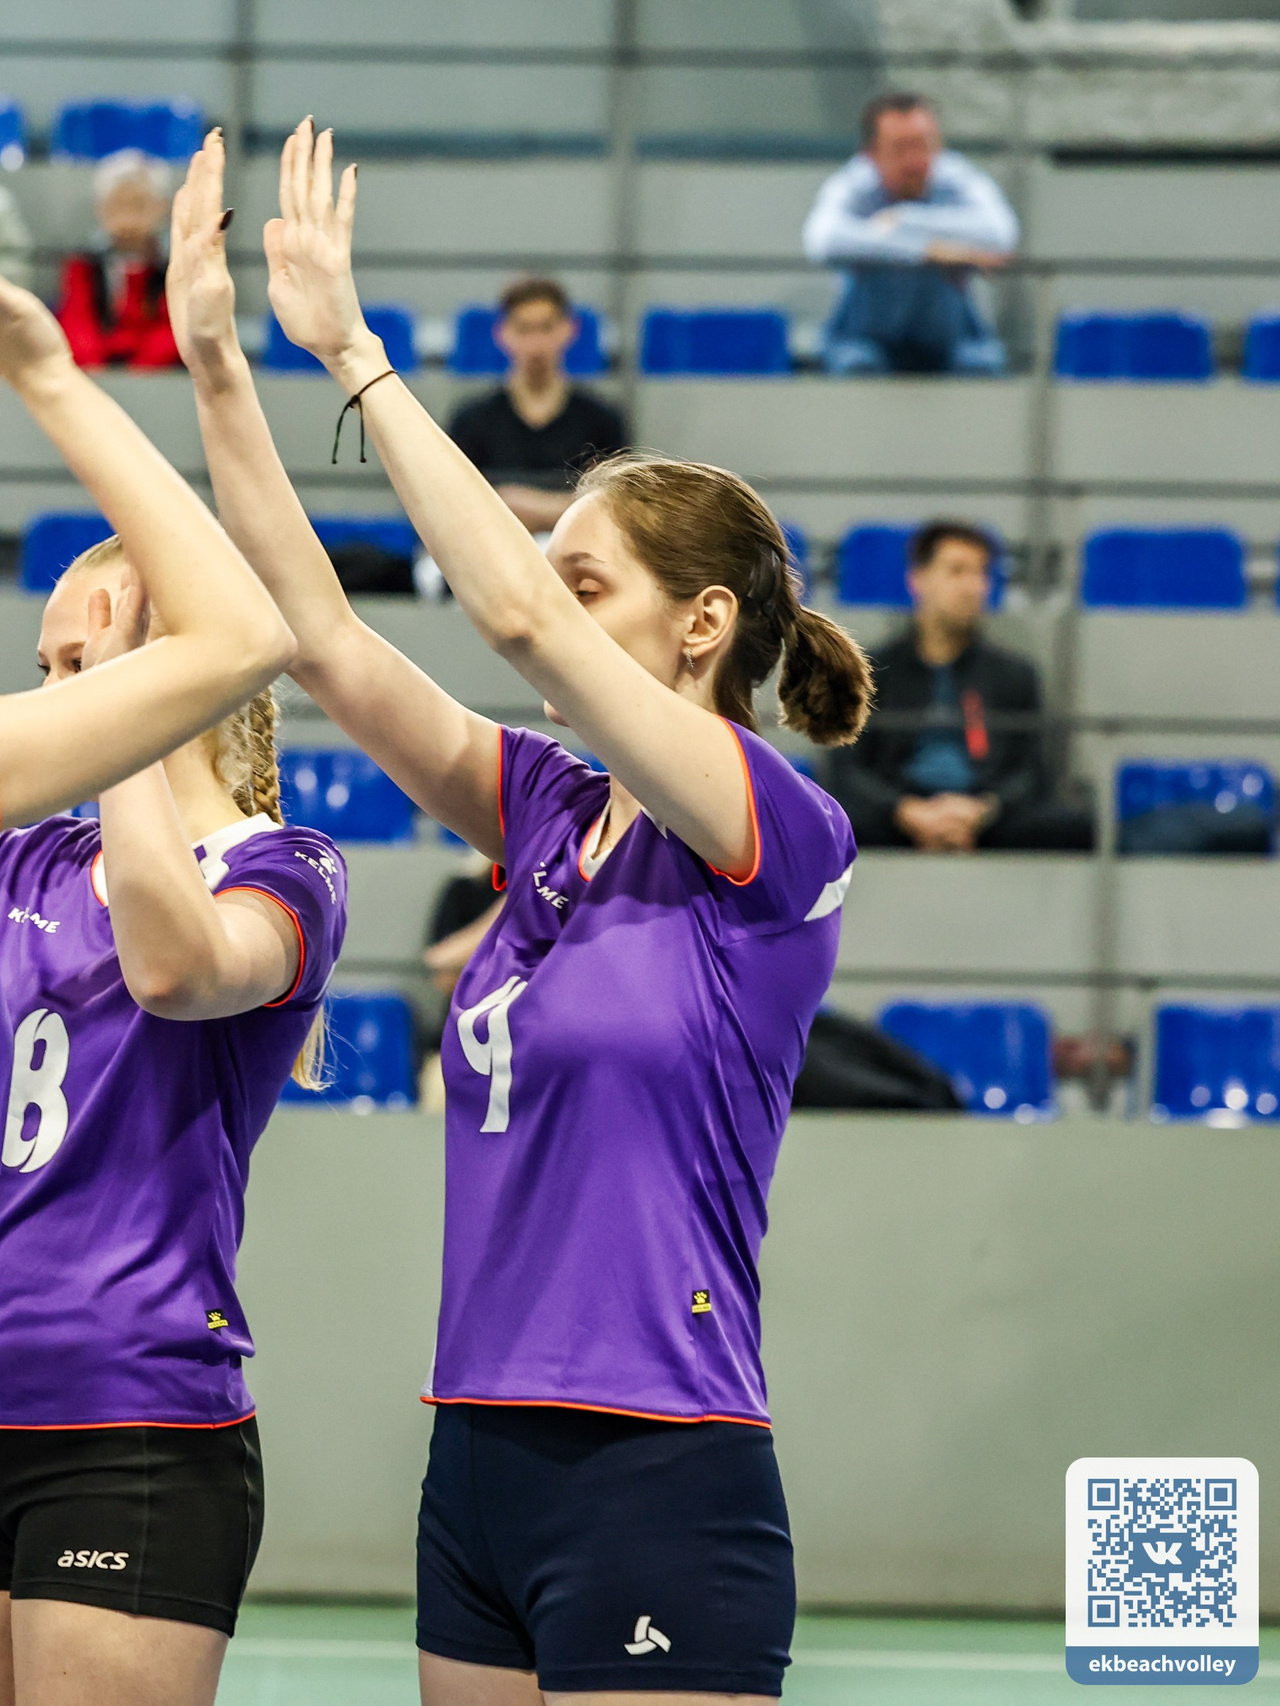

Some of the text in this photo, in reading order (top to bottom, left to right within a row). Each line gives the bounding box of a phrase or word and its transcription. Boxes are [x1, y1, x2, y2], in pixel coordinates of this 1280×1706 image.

[7, 906, 61, 933] KME
[1, 1008, 70, 1174] 8
[457, 975, 529, 1133] 9
